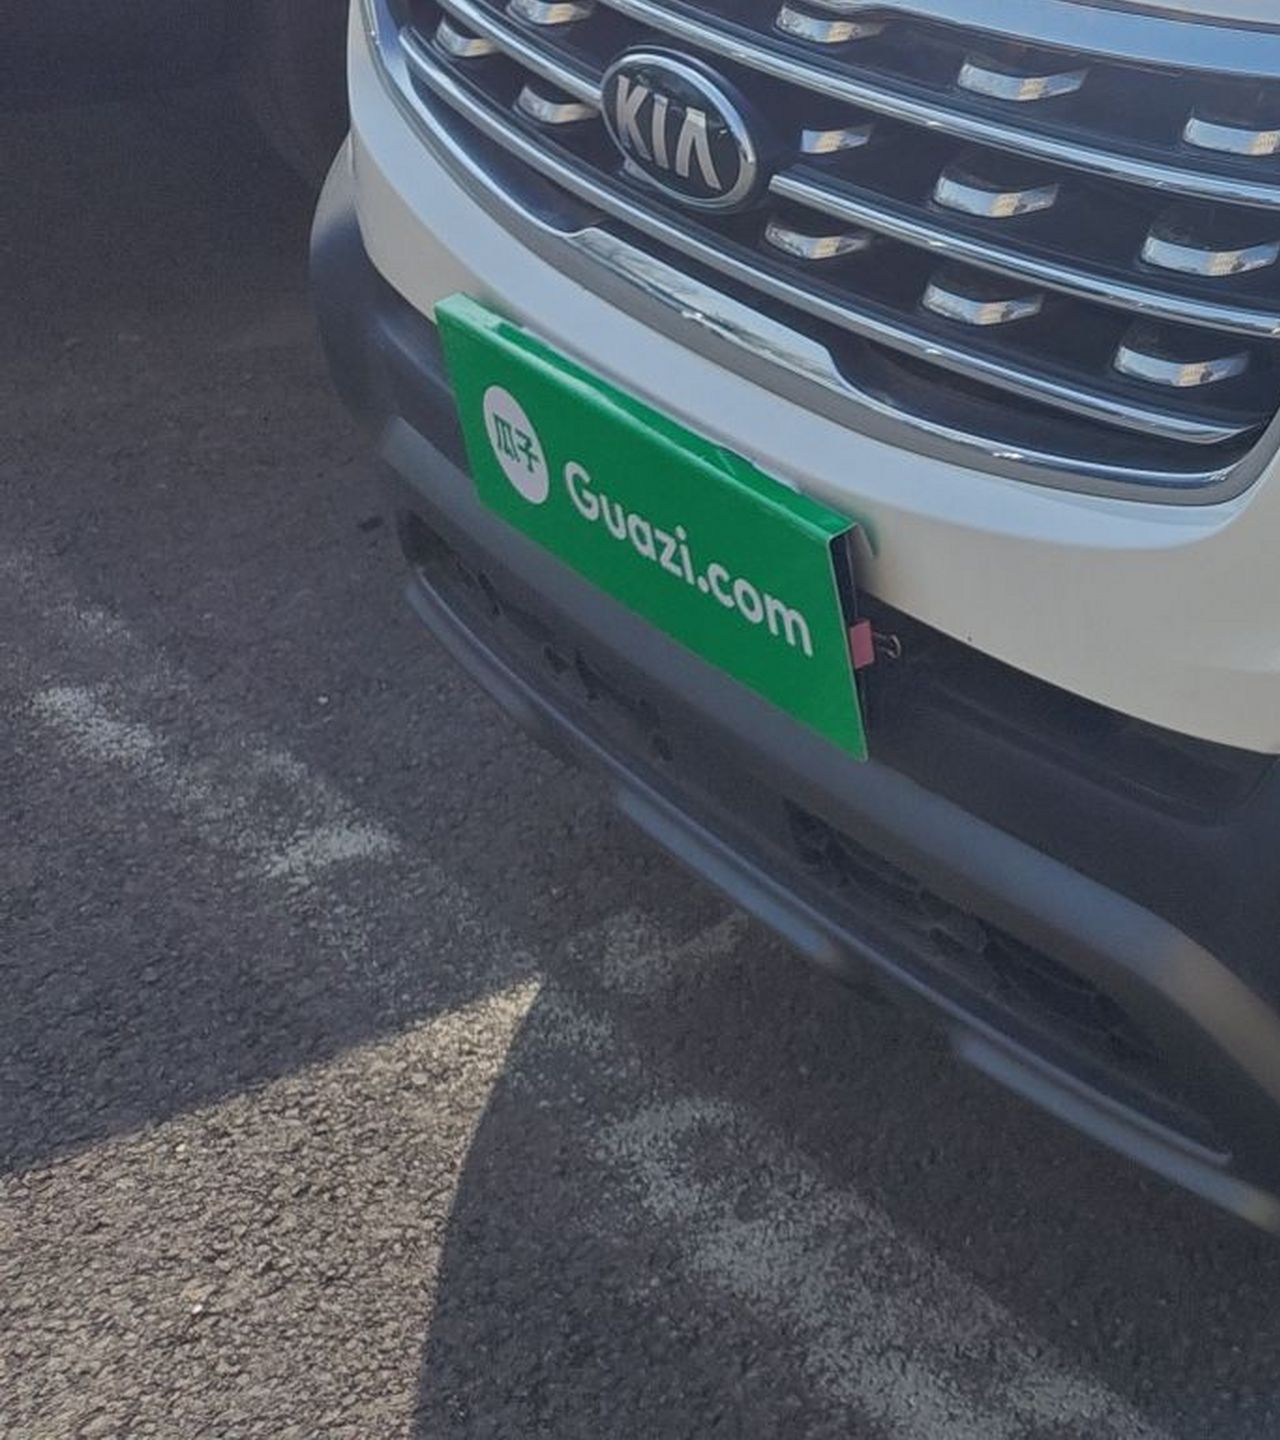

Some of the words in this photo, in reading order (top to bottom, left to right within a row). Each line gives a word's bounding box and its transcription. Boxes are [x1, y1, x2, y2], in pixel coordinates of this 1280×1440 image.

[616, 74, 722, 191] KIA
[494, 414, 539, 473] 瓜子
[564, 461, 813, 657] Guazi.com
